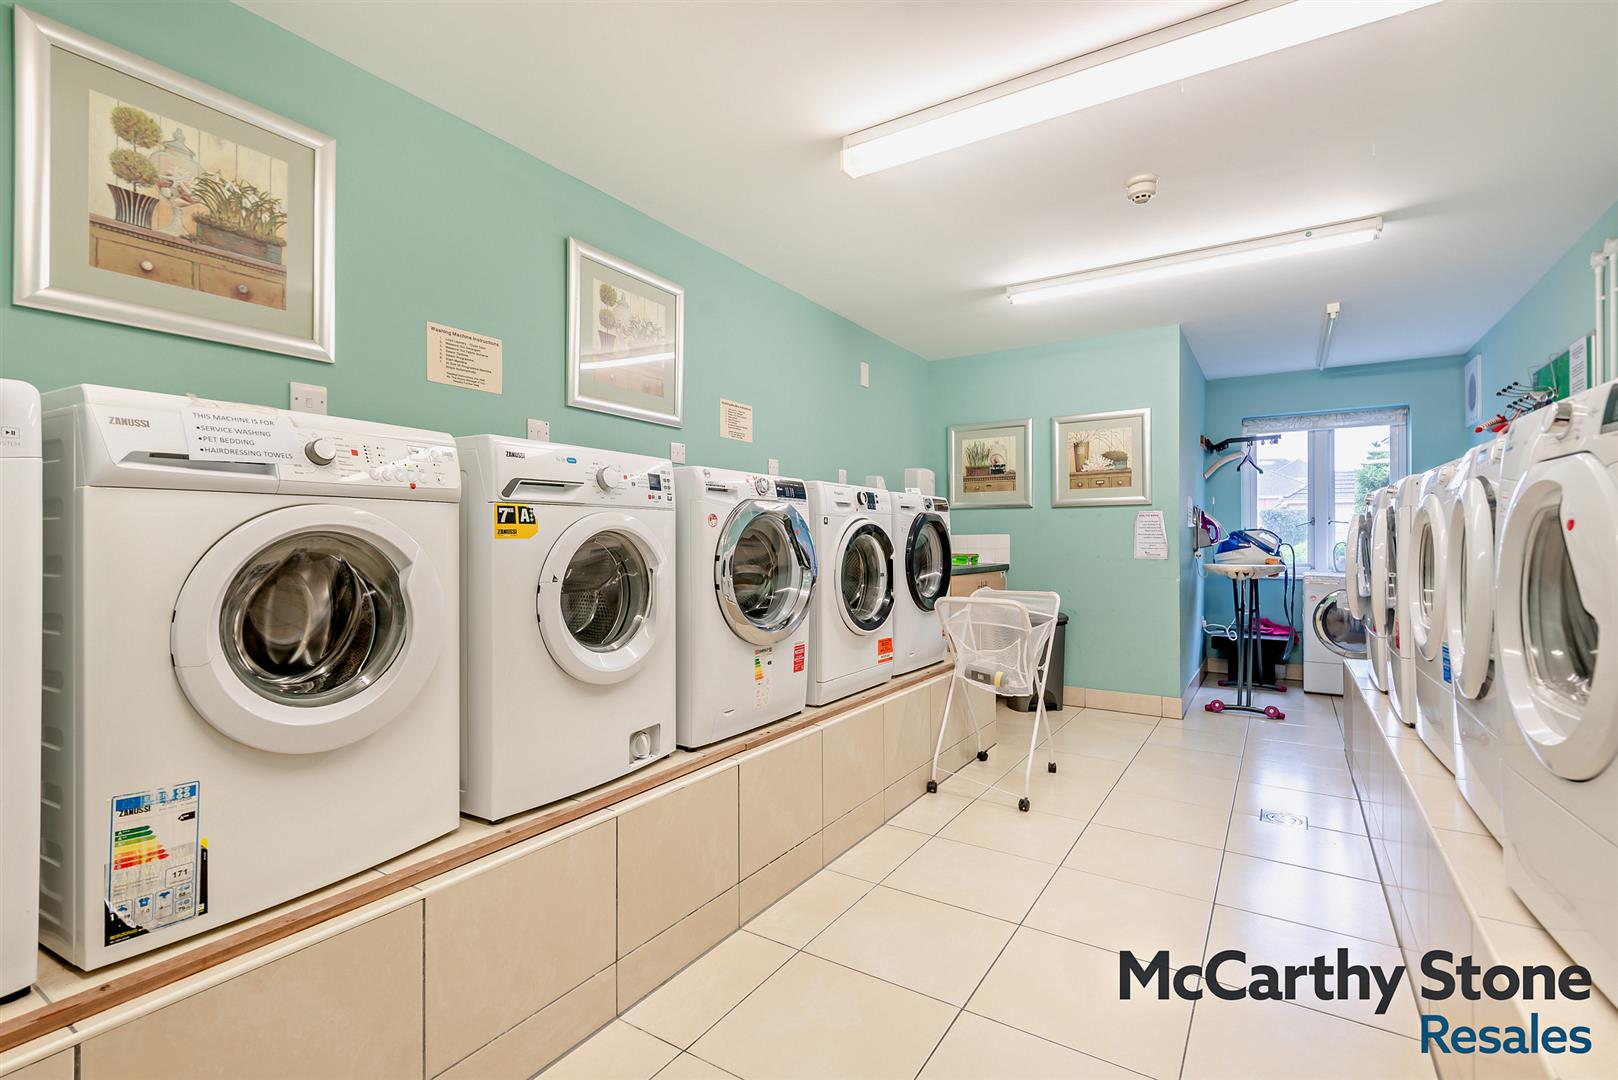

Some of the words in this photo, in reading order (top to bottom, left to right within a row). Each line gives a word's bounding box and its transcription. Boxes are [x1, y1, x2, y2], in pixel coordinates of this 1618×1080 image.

[431, 326, 451, 335] Washing
[453, 332, 471, 340] Machine
[473, 337, 499, 347] Instructions
[108, 416, 150, 428] ZANUSSI
[192, 412, 211, 420] THIS
[212, 414, 250, 424] MACHINE
[200, 425, 233, 434] SERVICE
[234, 428, 271, 437] WASHING
[220, 438, 255, 446] BEDDING
[205, 447, 262, 458] HAIRDRESSING
[264, 451, 294, 460] TOWELS
[119, 805, 151, 817] ZANUSSI
[172, 869, 188, 878] 171
